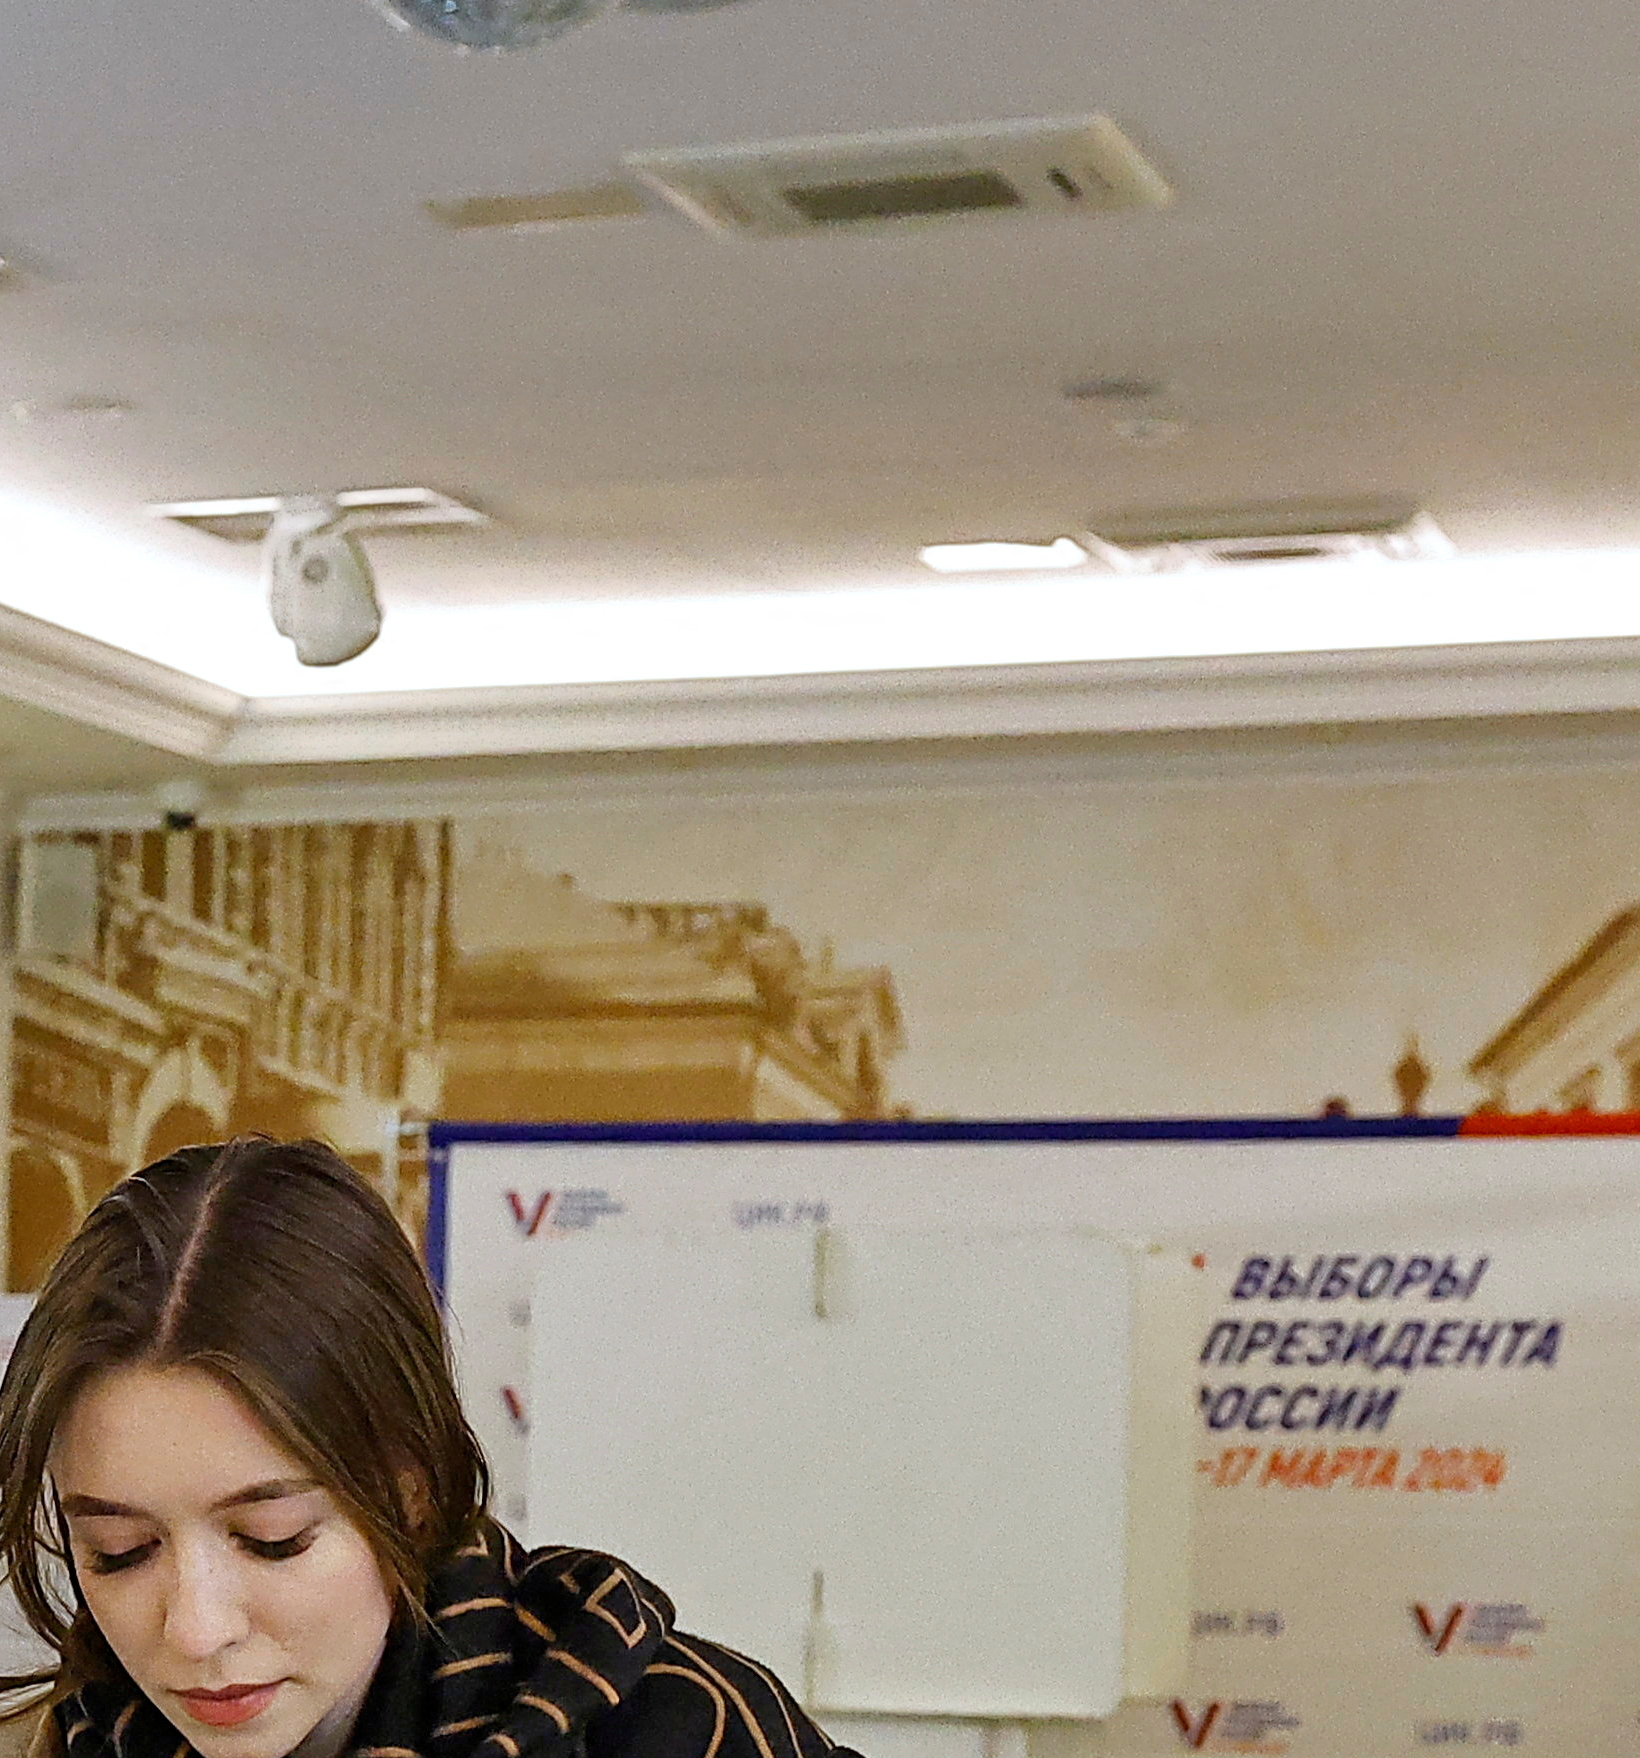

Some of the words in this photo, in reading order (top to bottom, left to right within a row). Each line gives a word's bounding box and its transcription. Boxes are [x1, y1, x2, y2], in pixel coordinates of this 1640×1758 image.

[1231, 1255, 1490, 1301] ВЫБОРЫ
[1199, 1319, 1563, 1374] ПРЕЗИДЕНТА
[1258, 1446, 1401, 1489] МАРТА
